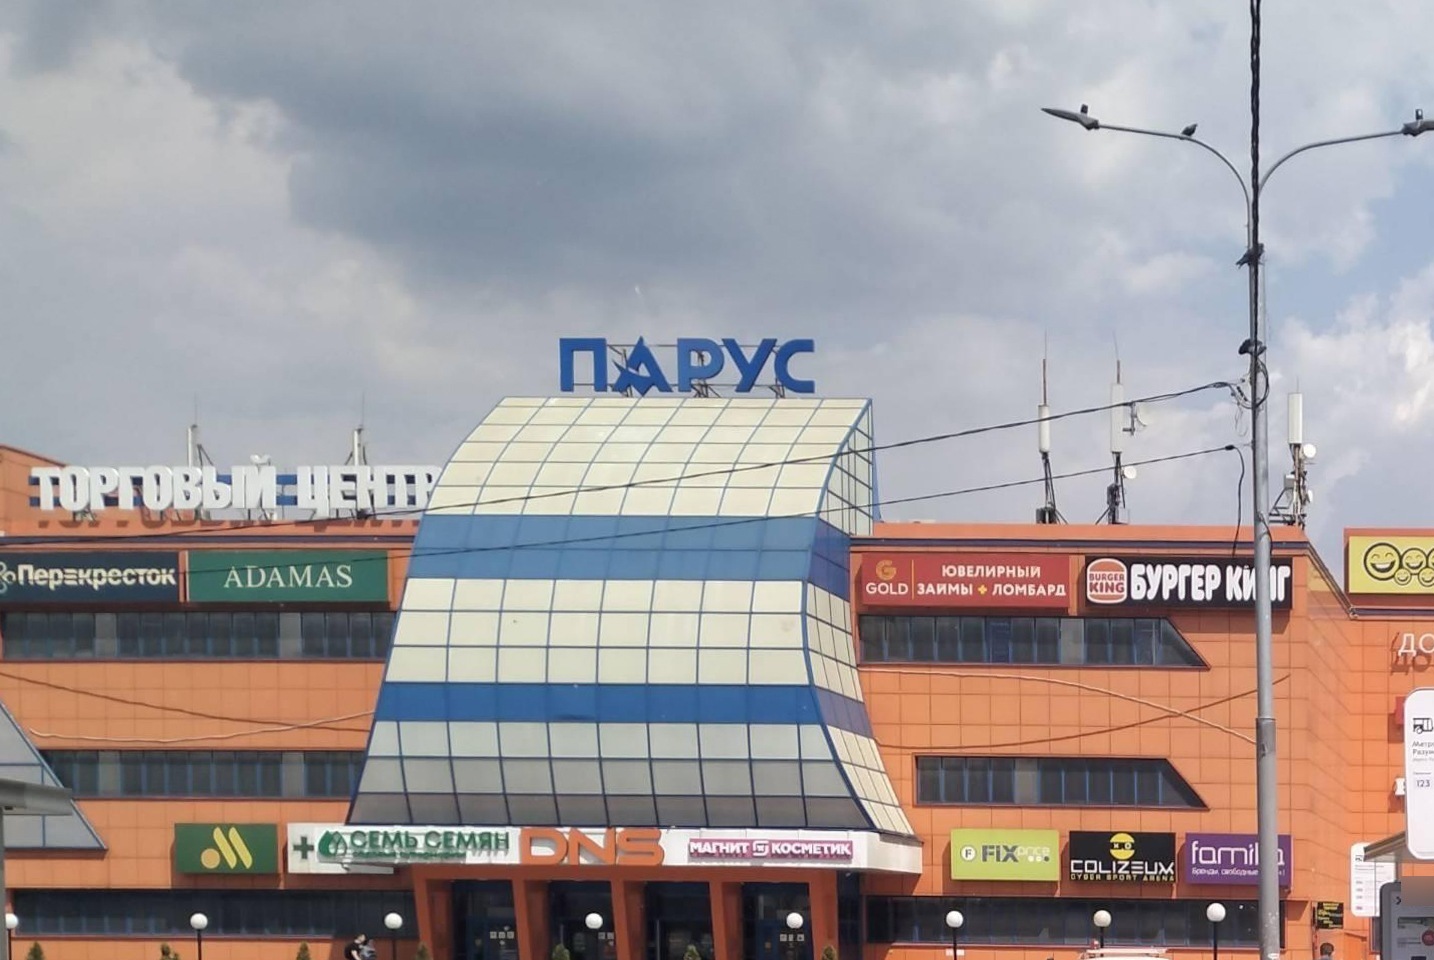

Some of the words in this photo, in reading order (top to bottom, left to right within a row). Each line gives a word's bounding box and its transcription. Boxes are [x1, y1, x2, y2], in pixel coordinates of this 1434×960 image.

[559, 336, 815, 395] ПАРУС
[30, 455, 277, 512] ТОРГОВЫЙ
[297, 465, 442, 517] ЦЕНТР
[17, 564, 176, 590] Перекресток
[224, 564, 353, 588] ADAMAS
[942, 565, 1041, 578] ЮВЕЛИРНЫЙ
[1089, 573, 1125, 582] BURGER
[1130, 564, 1222, 601] БУРГЕР
[866, 582, 908, 595] GOLD
[917, 583, 973, 596] ЗАЙМЫ
[992, 584, 1066, 597] ЛОМБАРД
[1089, 582, 1125, 594] KING
[351, 831, 418, 849] СЕМЬ
[425, 831, 510, 851] СЕМЯН
[519, 828, 665, 865] DNS
[689, 841, 750, 854] МАГНИТ
[771, 842, 852, 856] КОСМЕТИК
[1192, 841, 1285, 865] famil
